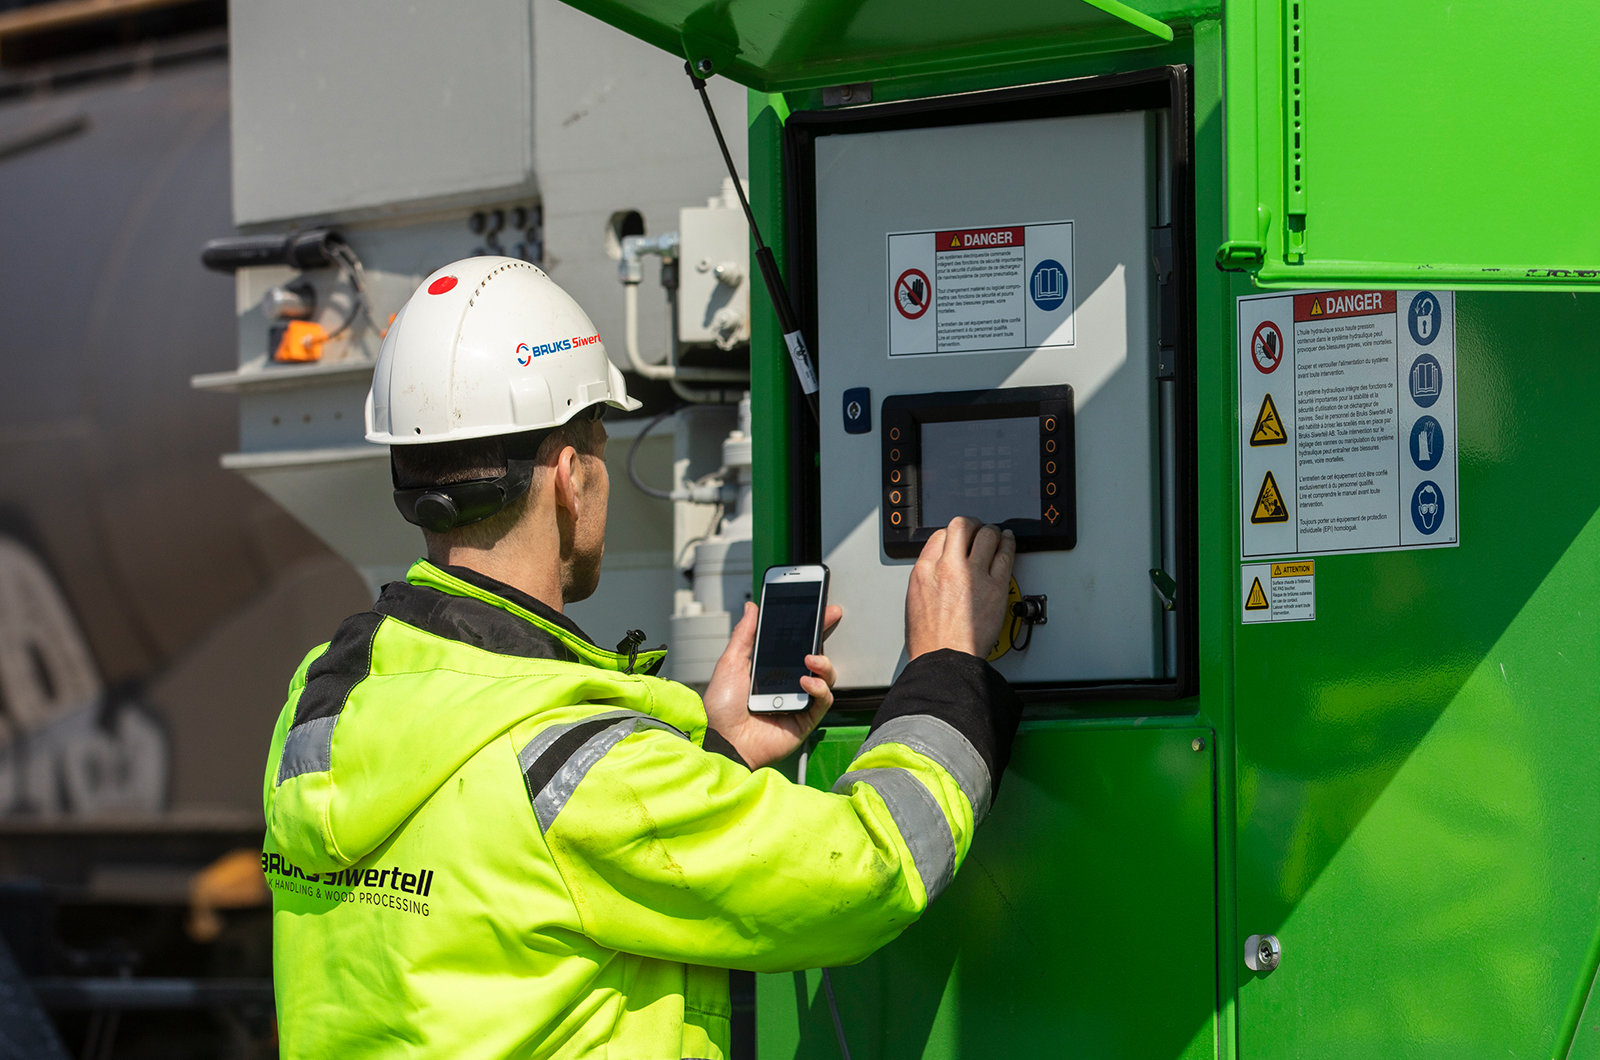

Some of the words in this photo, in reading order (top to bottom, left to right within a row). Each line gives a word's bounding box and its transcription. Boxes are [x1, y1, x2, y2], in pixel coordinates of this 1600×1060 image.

[964, 232, 1013, 246] DANGER
[1326, 292, 1382, 314] DANGER
[532, 339, 572, 357] BRUKS
[275, 878, 313, 896] HANDLING
[316, 888, 321, 898] &
[325, 890, 355, 903] WOOD
[360, 892, 430, 916] PROCESSING
